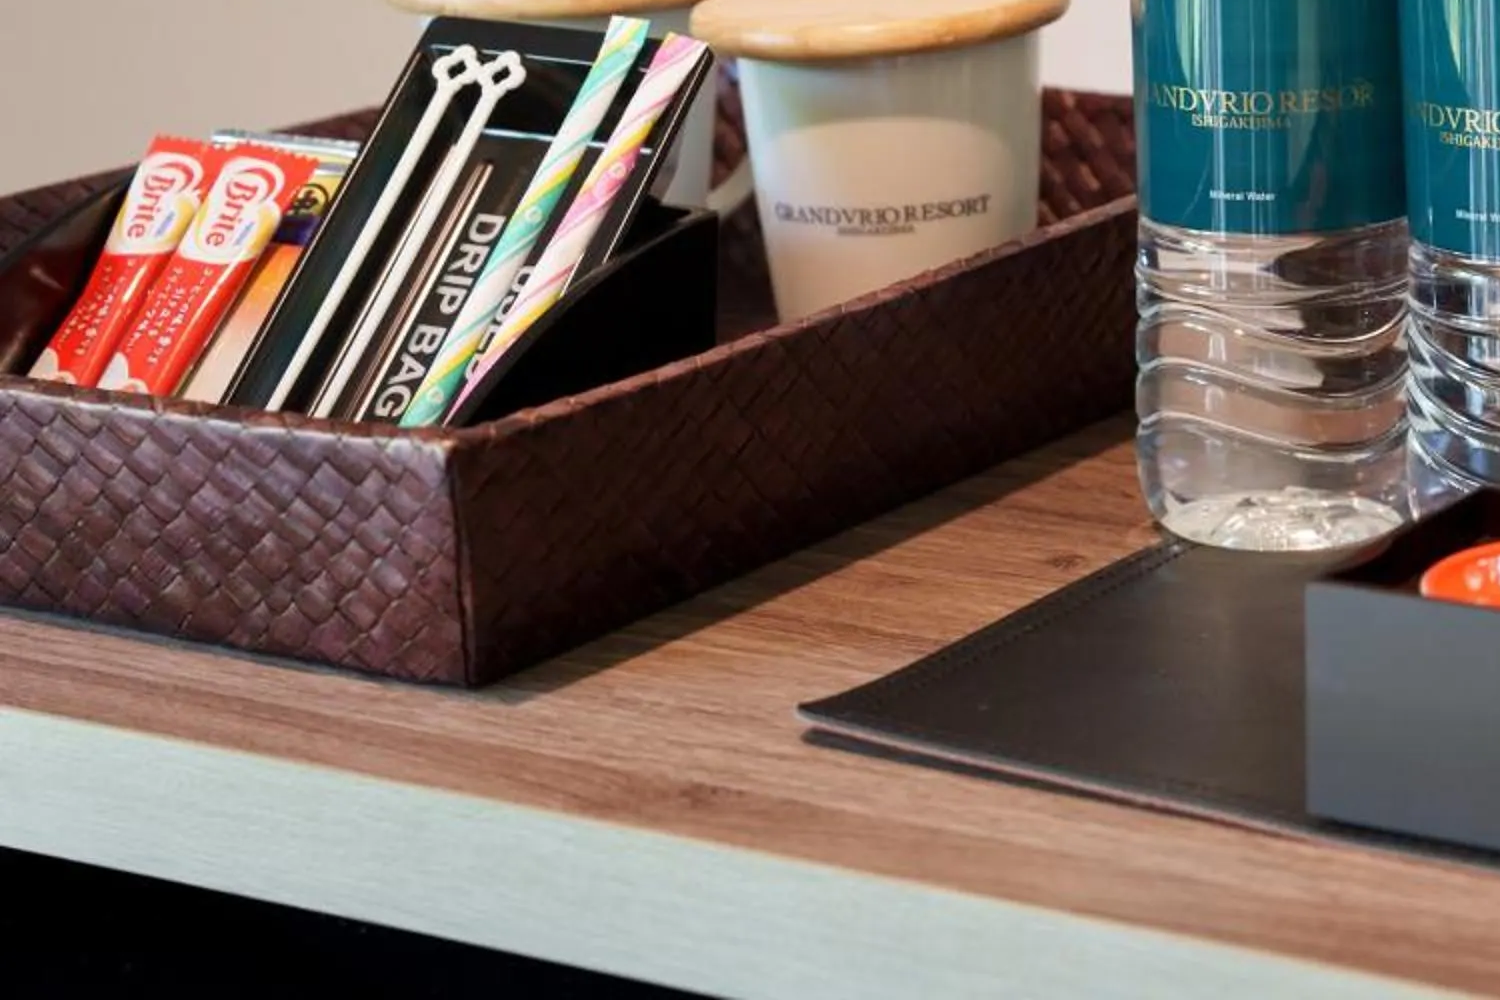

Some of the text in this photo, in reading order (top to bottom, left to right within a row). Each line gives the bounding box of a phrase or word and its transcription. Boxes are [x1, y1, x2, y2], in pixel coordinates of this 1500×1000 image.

[205, 180, 258, 247] Brite
[904, 194, 991, 223] RESORT
[436, 212, 507, 317] DRIP
[373, 323, 448, 420] BAG
